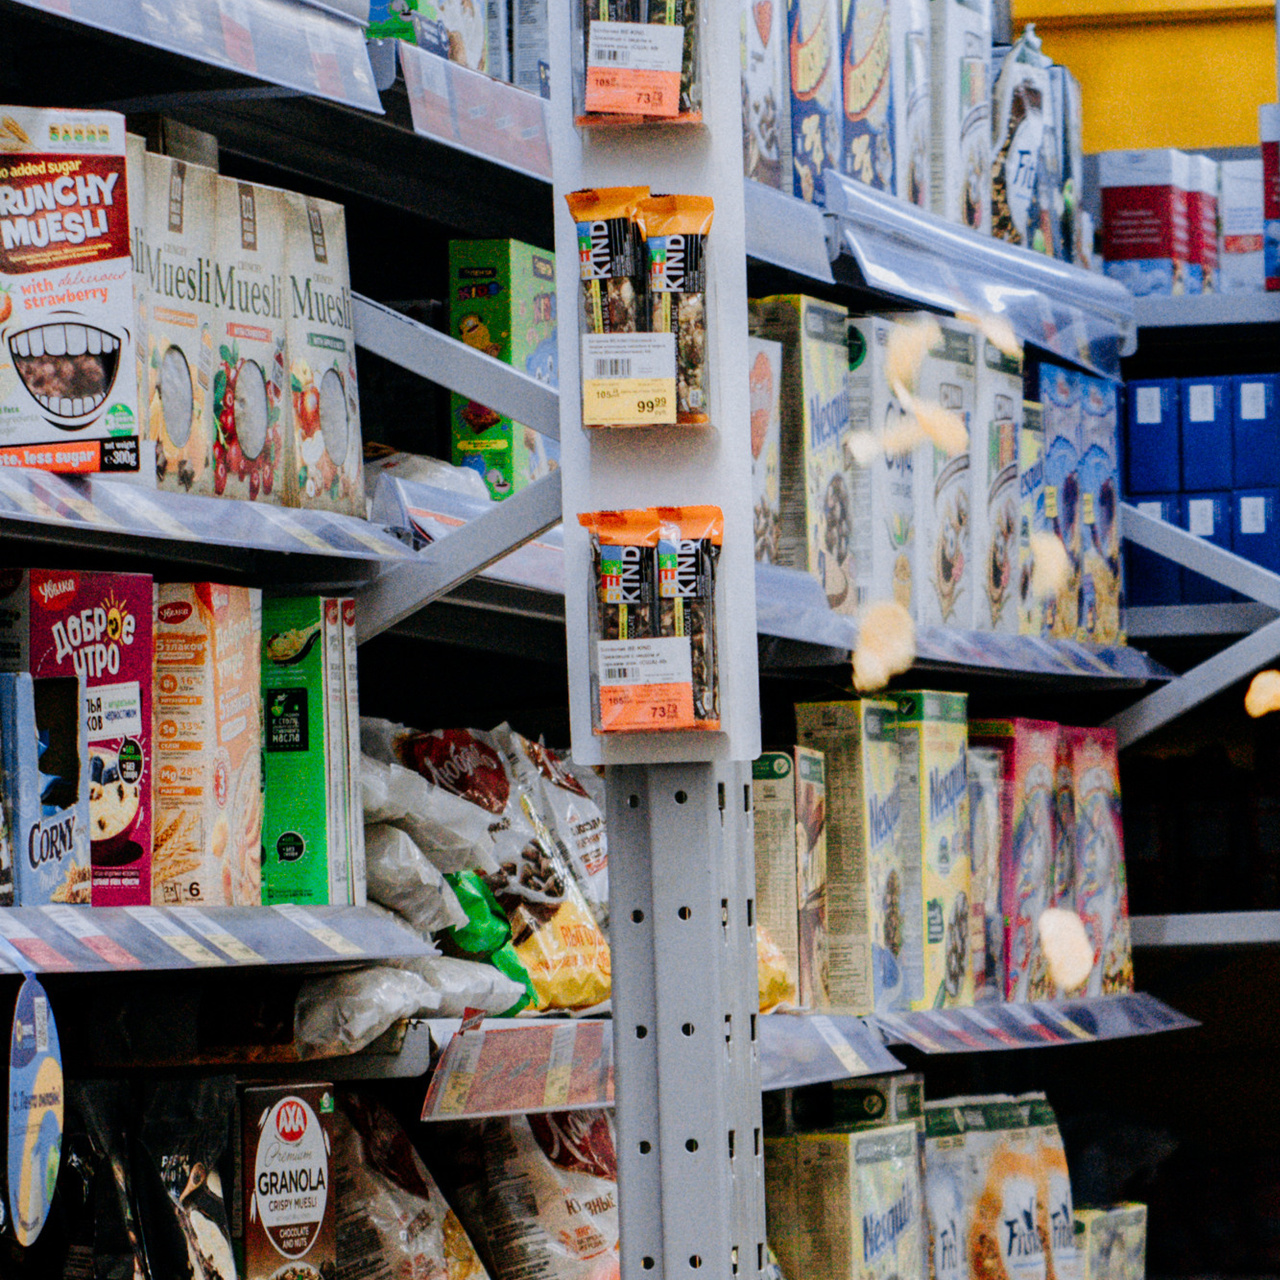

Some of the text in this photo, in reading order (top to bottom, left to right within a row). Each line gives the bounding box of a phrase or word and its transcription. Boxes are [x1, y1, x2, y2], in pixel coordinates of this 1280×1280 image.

[636, 92, 651, 104] 73
[10, 162, 47, 176] added
[47, 160, 82, 175] sugar
[0, 208, 109, 250] MUESLI
[592, 220, 613, 280] KIND
[665, 234, 686, 293] KIND
[146, 242, 211, 303] Muesli
[21, 278, 53, 295] with
[24, 287, 108, 311] strawberry
[214, 262, 282, 319] Muesli
[289, 274, 352, 330] Muesli
[637, 401, 655, 413] 99
[24, 451, 53, 465] less
[55, 450, 95, 467] sugar
[621, 545, 642, 605] KIND
[677, 539, 698, 598] KIND
[651, 706, 667, 718] 73
[161, 770, 177, 782] Mg
[28, 816, 76, 870] CORNY
[188, 881, 201, 897] 6
[278, 1103, 305, 1134] AXA
[257, 1166, 327, 1197] GRANOLA
[268, 1195, 318, 1213] CRISPY MUESLI
[279, 1225, 310, 1239] CHOCOLATE
